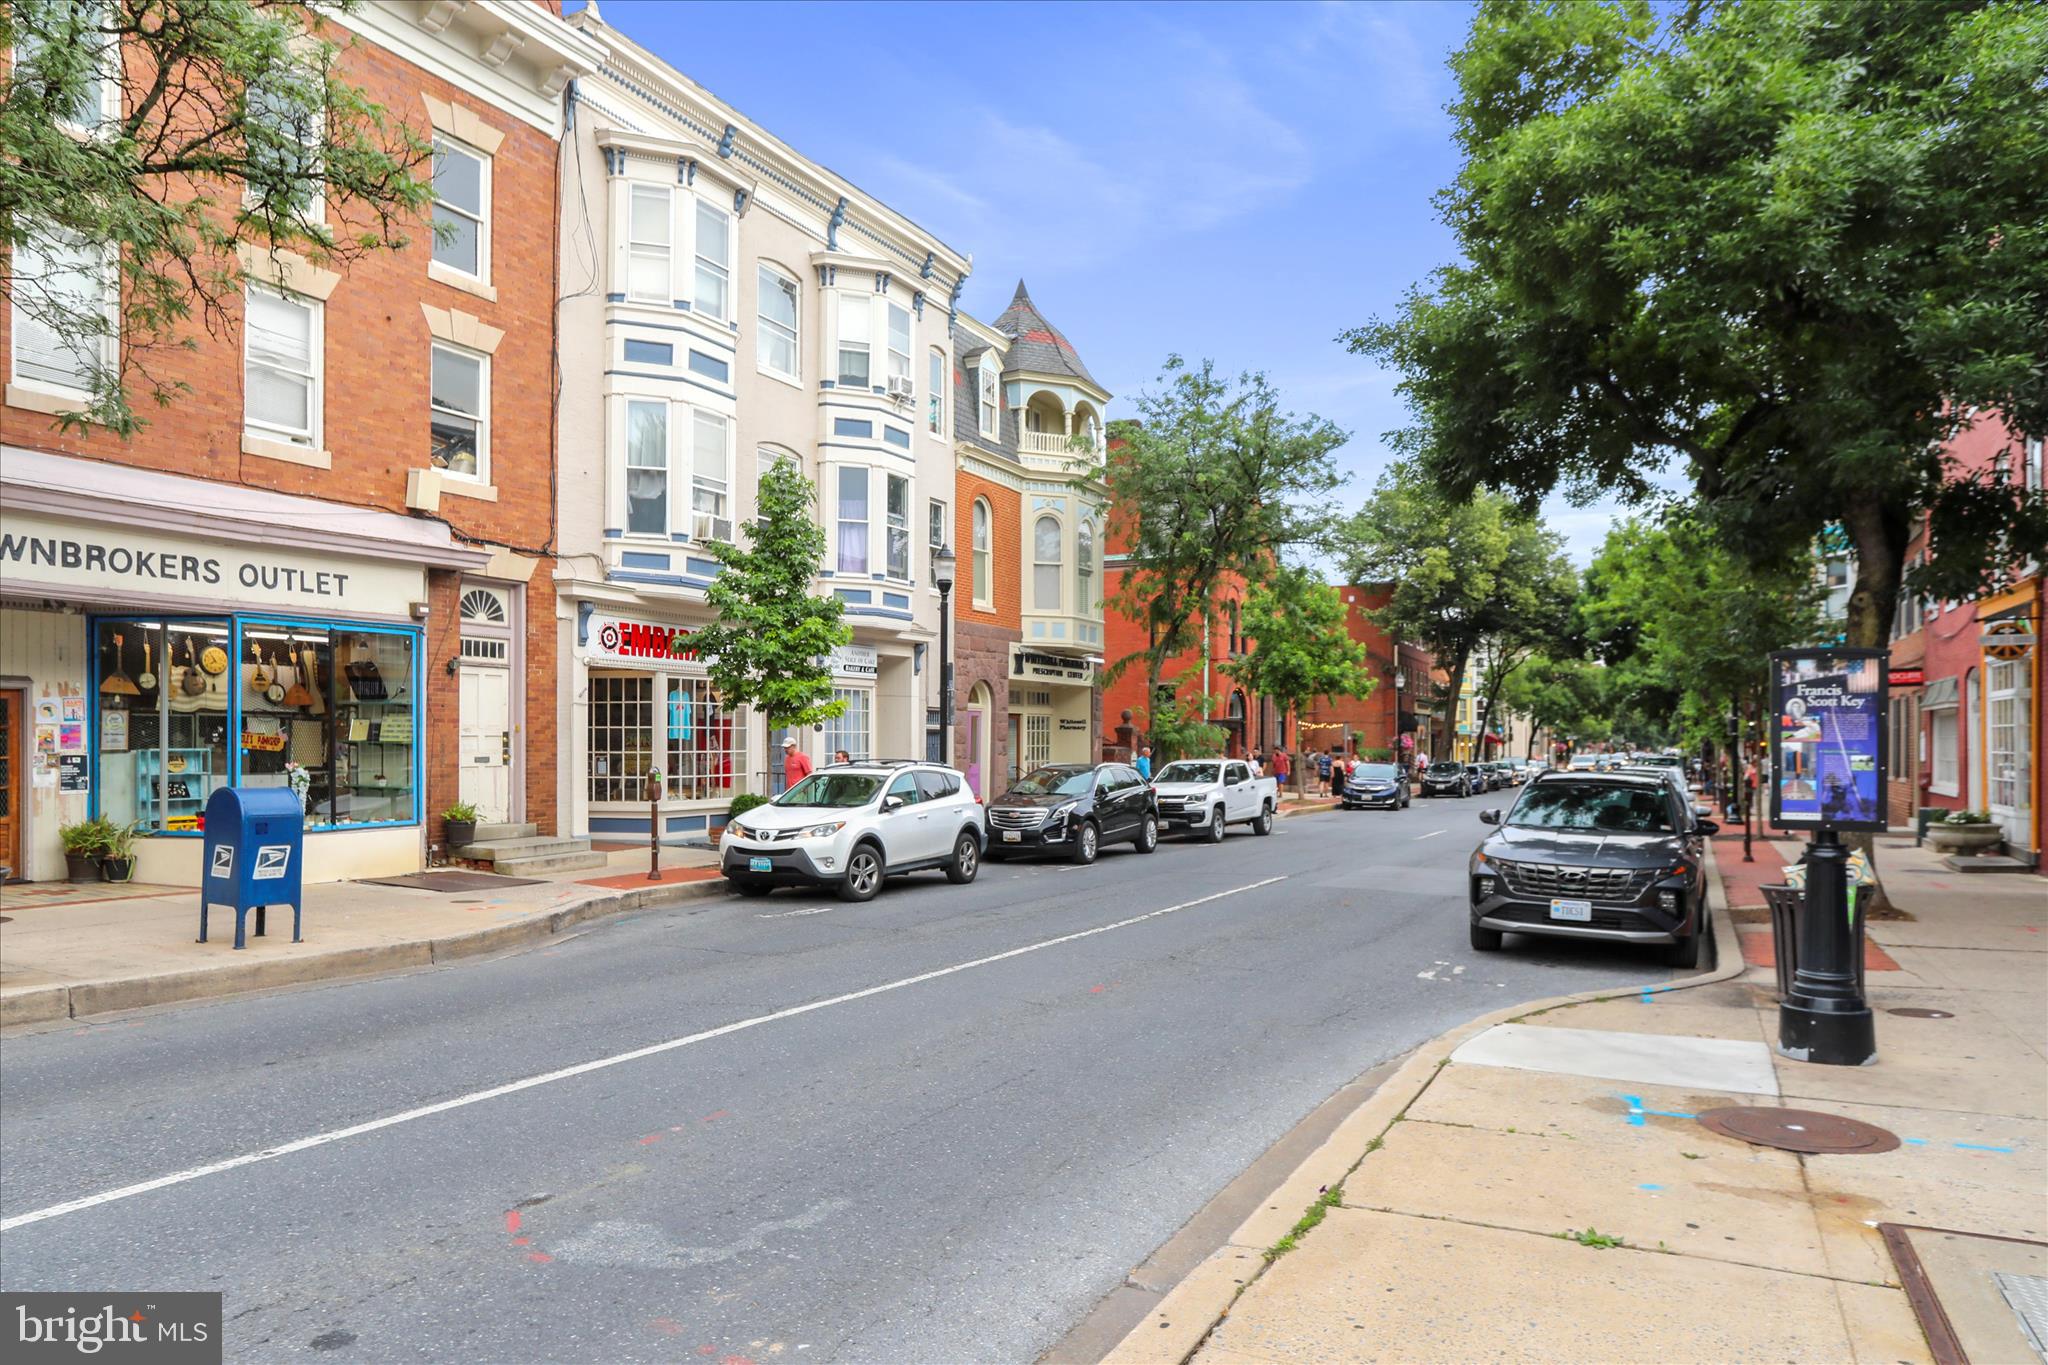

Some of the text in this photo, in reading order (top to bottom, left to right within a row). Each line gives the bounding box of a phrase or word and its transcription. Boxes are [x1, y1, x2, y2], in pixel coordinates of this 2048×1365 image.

[239, 563, 349, 596] OUTLET
[1797, 683, 1842, 696] Francis
[1807, 695, 1866, 709] Scott Key
